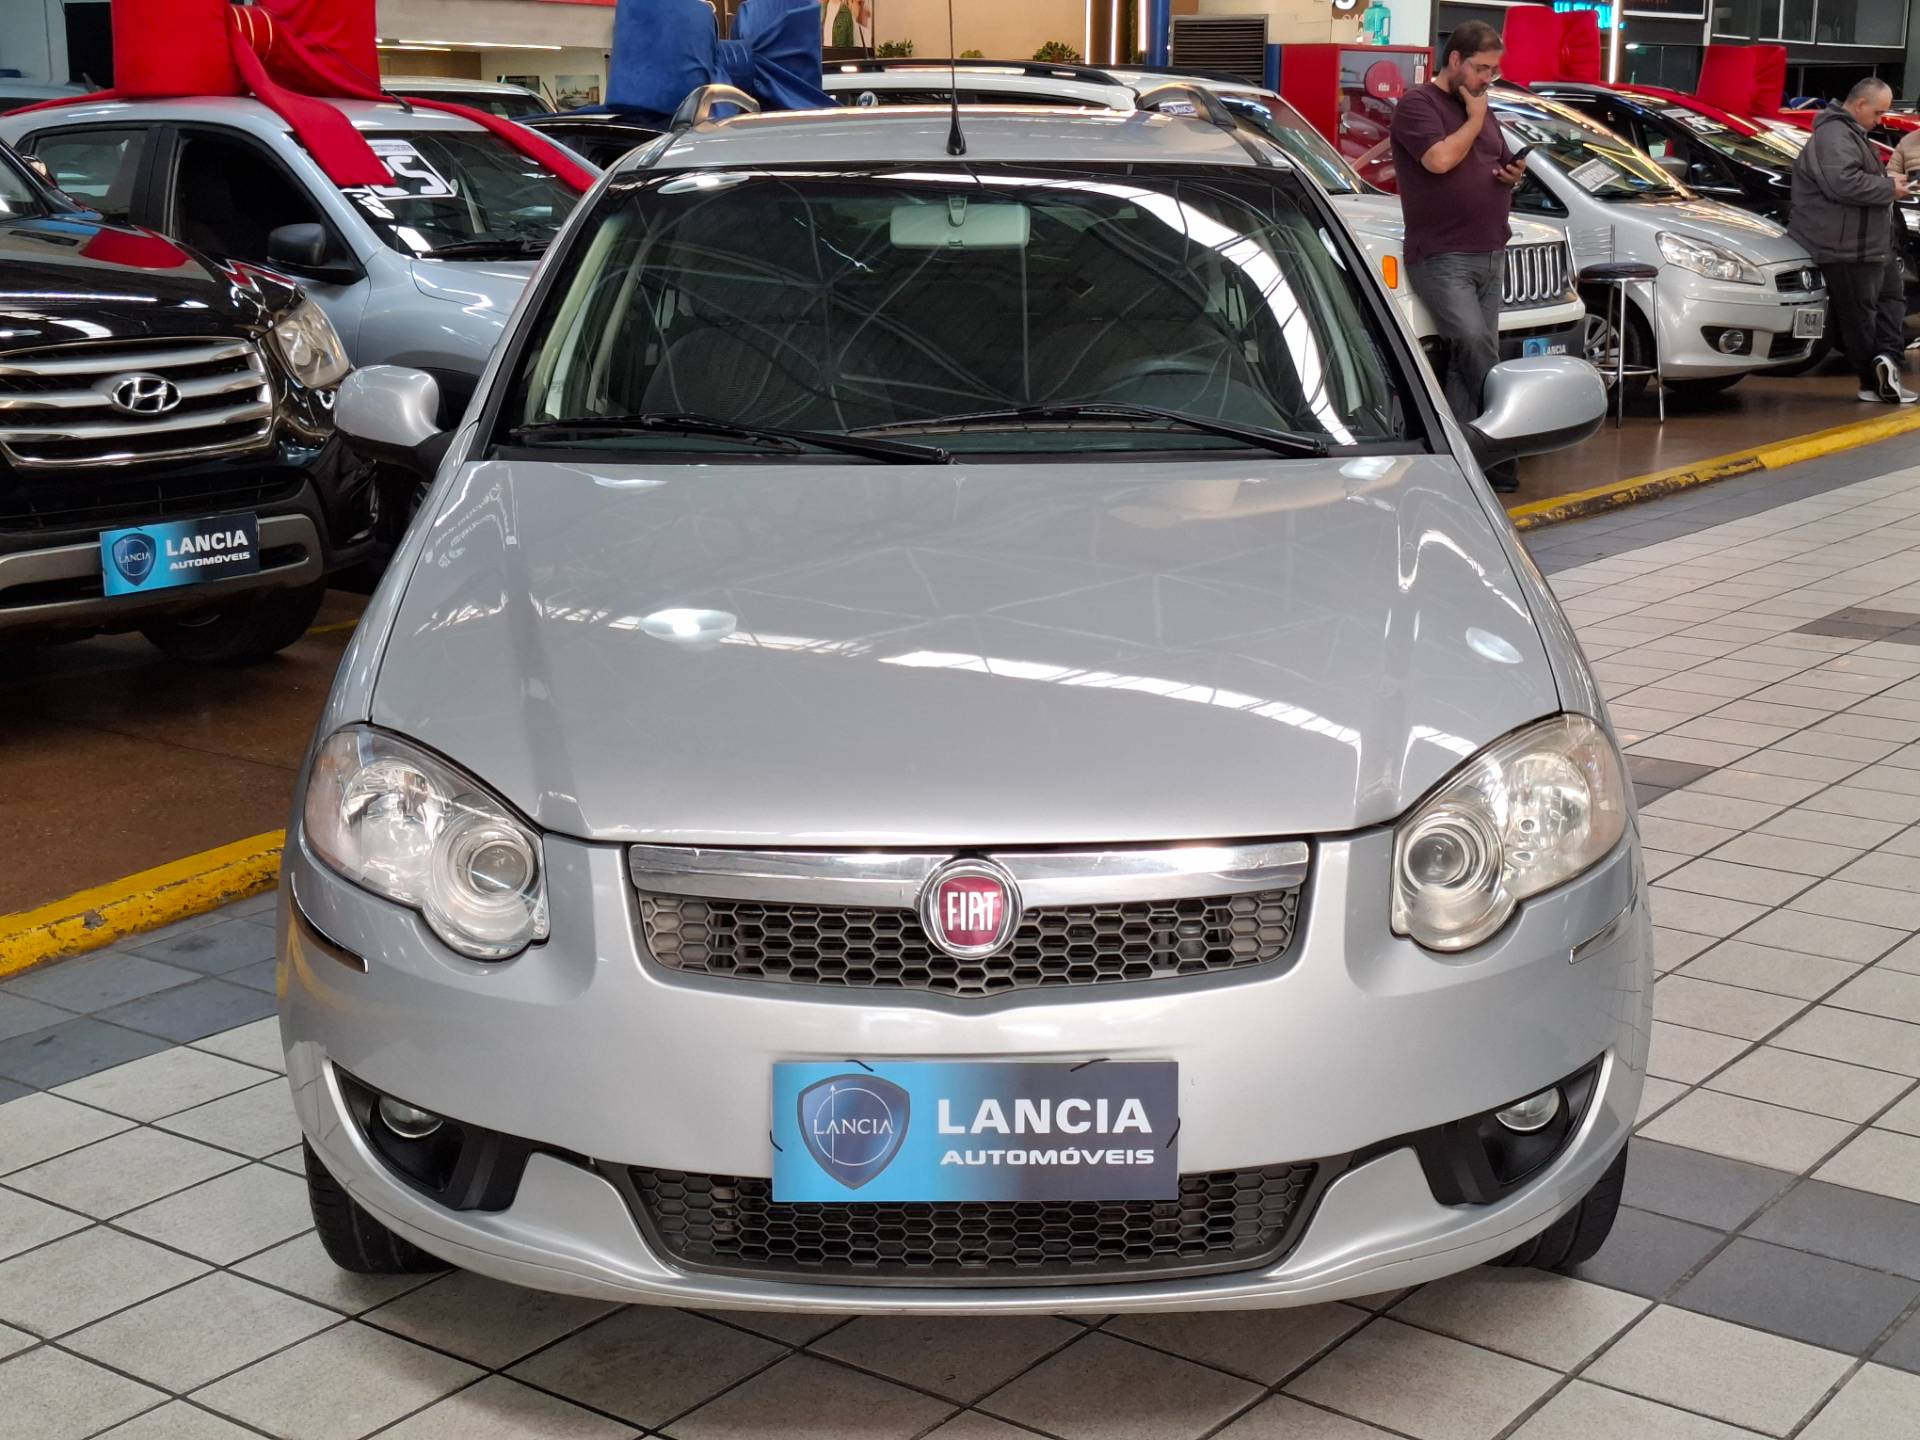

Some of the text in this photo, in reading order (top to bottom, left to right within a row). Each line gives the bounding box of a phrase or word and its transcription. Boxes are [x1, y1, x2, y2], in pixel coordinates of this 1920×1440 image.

[165, 529, 249, 557] LANCIA
[118, 551, 151, 564] LANCIA
[169, 551, 251, 571] AUTOMÓVEIS
[946, 891, 998, 931] FIAT
[813, 1117, 894, 1134] LANCIA
[938, 1098, 1153, 1134] LANCIA
[940, 1146, 1155, 1165] AUTOMÓVEIS
